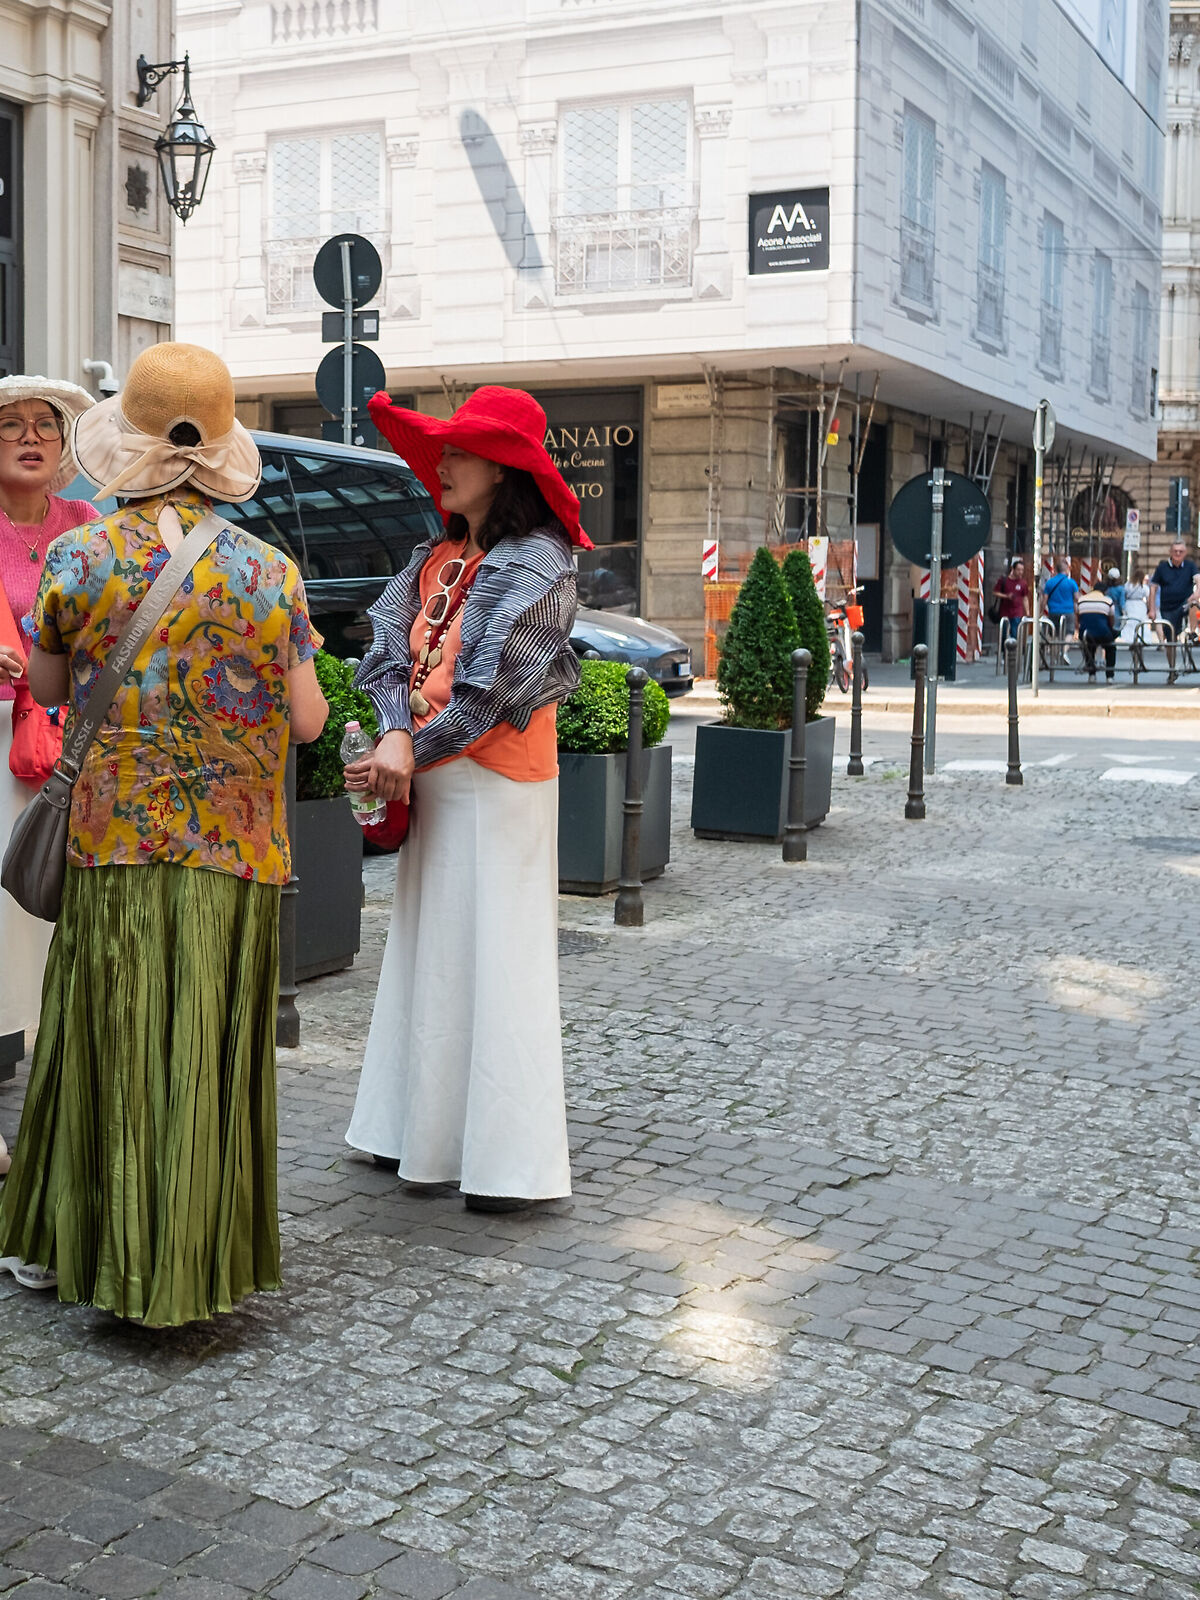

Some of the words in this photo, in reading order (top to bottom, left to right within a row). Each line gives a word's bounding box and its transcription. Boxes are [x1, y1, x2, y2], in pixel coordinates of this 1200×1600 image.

[543, 425, 634, 449] ANAIO
[571, 451, 605, 468] Cucina
[569, 483, 604, 498] ATO
[71, 719, 94, 759] ASSIC
